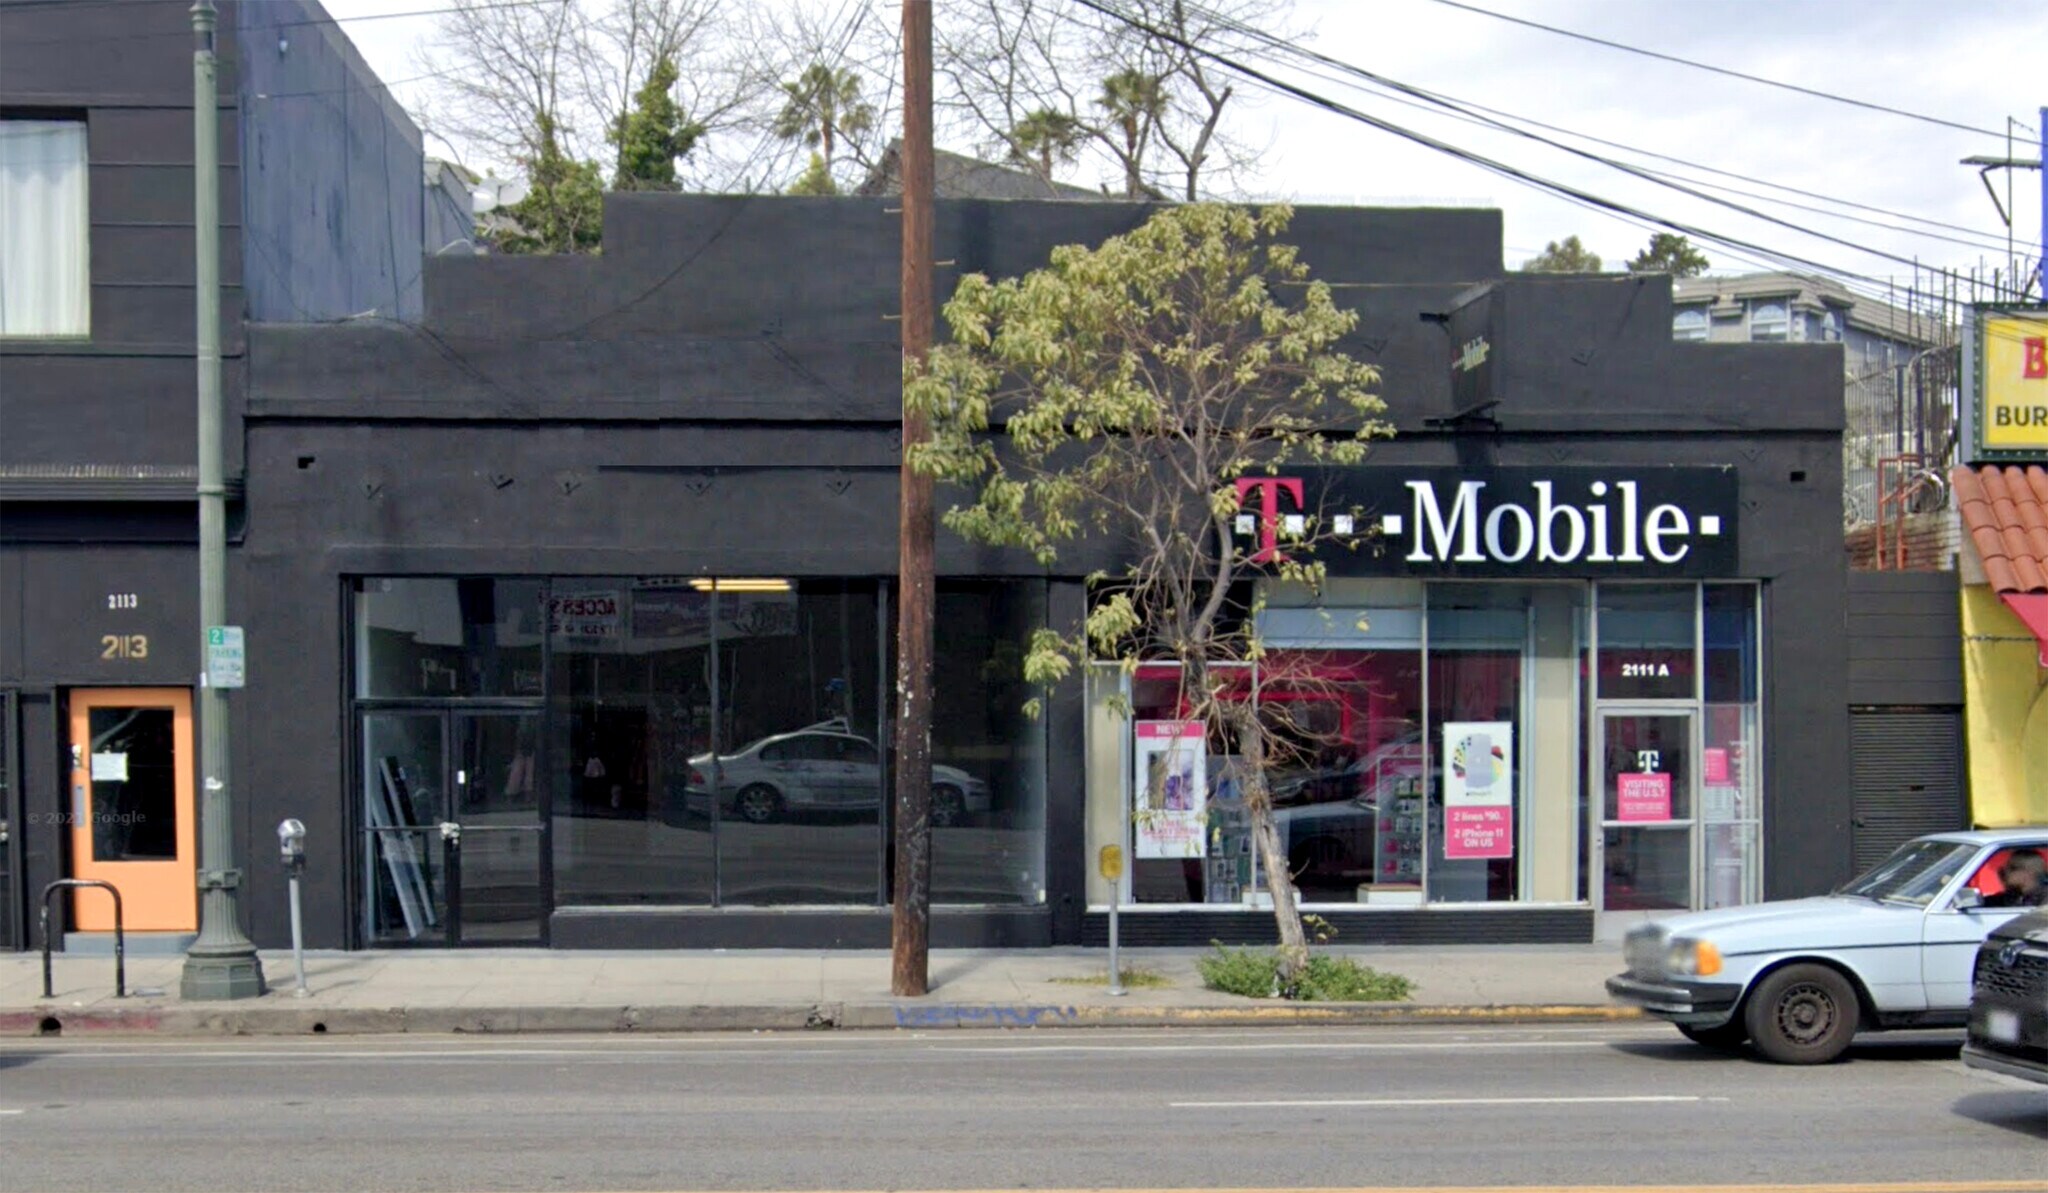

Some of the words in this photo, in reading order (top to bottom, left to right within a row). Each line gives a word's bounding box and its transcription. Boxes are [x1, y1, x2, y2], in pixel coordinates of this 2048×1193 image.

[1404, 480, 1691, 565] Mobile
[108, 593, 138, 610] 2113
[101, 634, 148, 659] 2113
[1621, 663, 1655, 677] 2111
[1657, 663, 1670, 677] A
[1453, 811, 1460, 822] 2
[1454, 828, 1460, 838] 2
[1462, 828, 1494, 838] iPhone
[1464, 838, 1478, 848] ON
[1480, 838, 1494, 848] US
